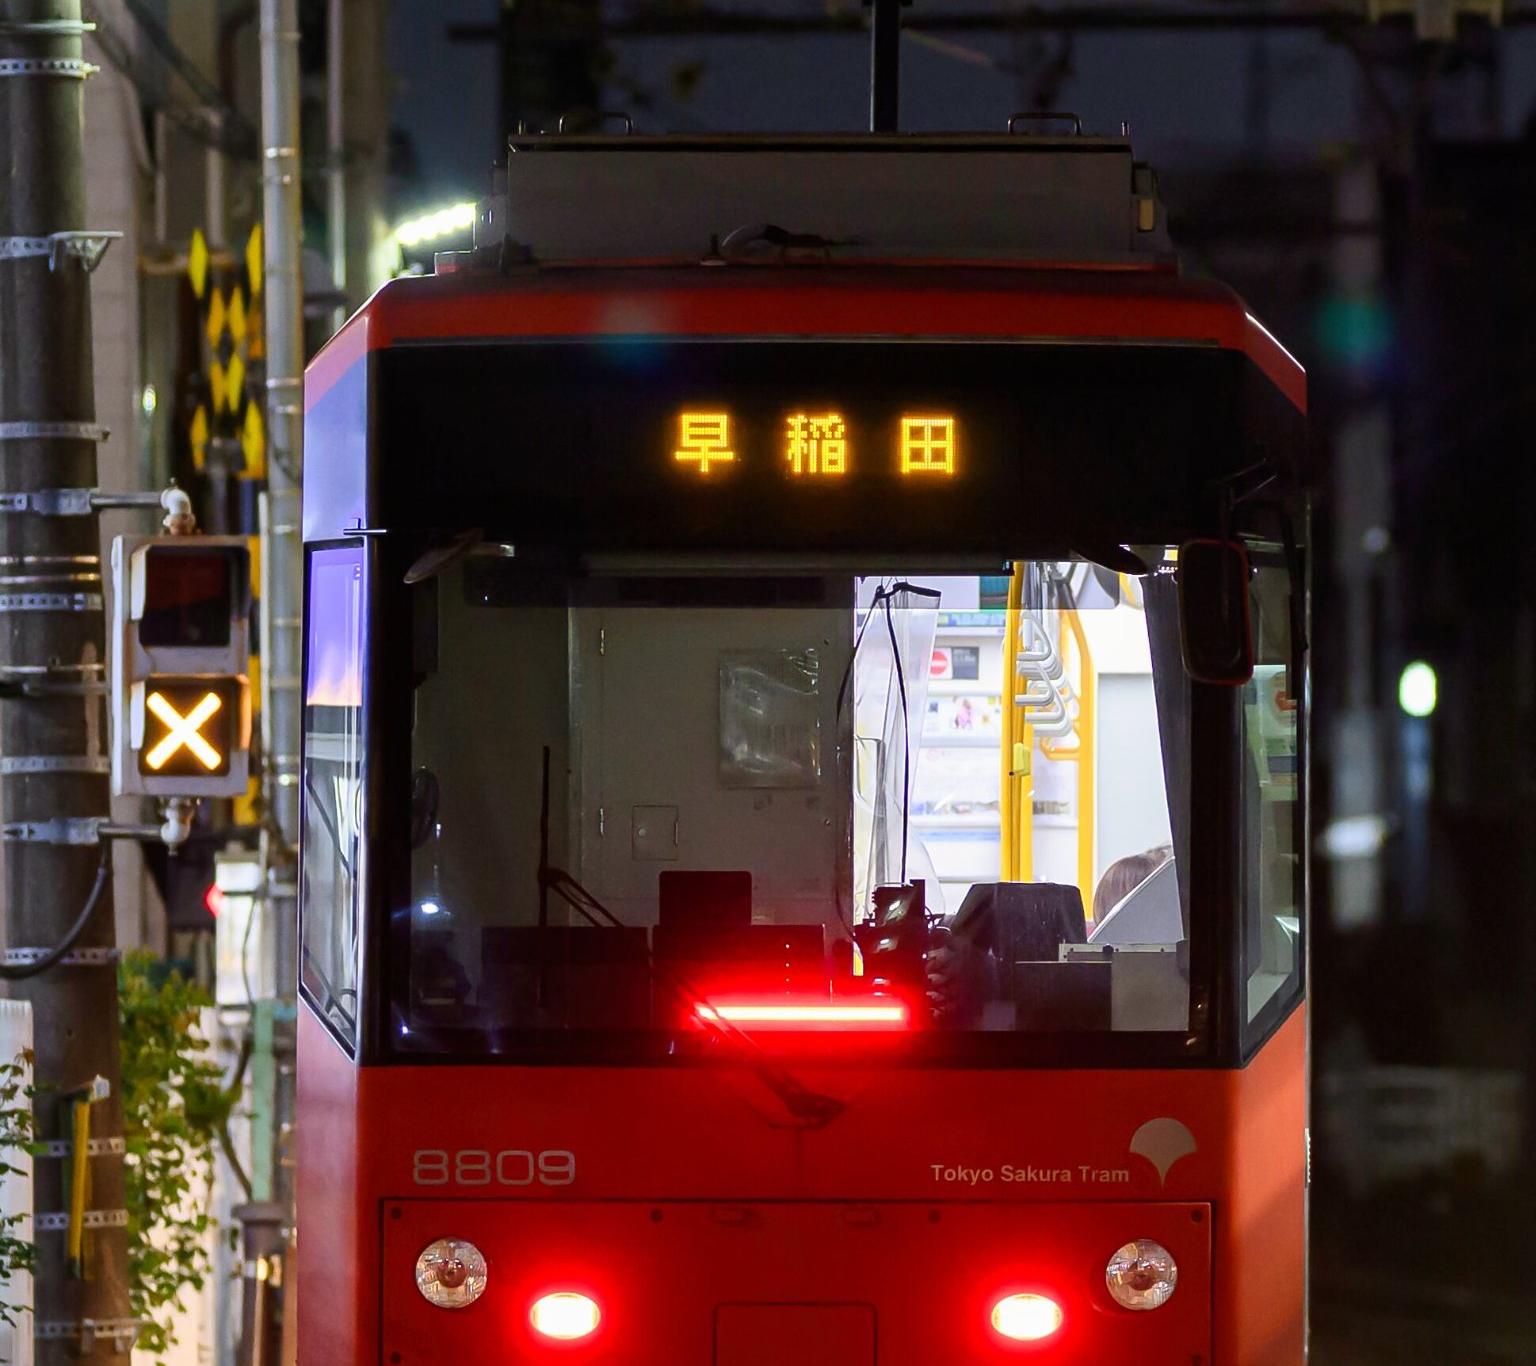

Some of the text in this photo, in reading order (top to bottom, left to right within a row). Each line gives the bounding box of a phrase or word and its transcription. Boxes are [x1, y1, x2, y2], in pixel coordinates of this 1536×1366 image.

[674, 413, 954, 474] 早稲田
[413, 1149, 576, 1186] 8809
[930, 1164, 1130, 1186] Tokyo Sakura Tram
